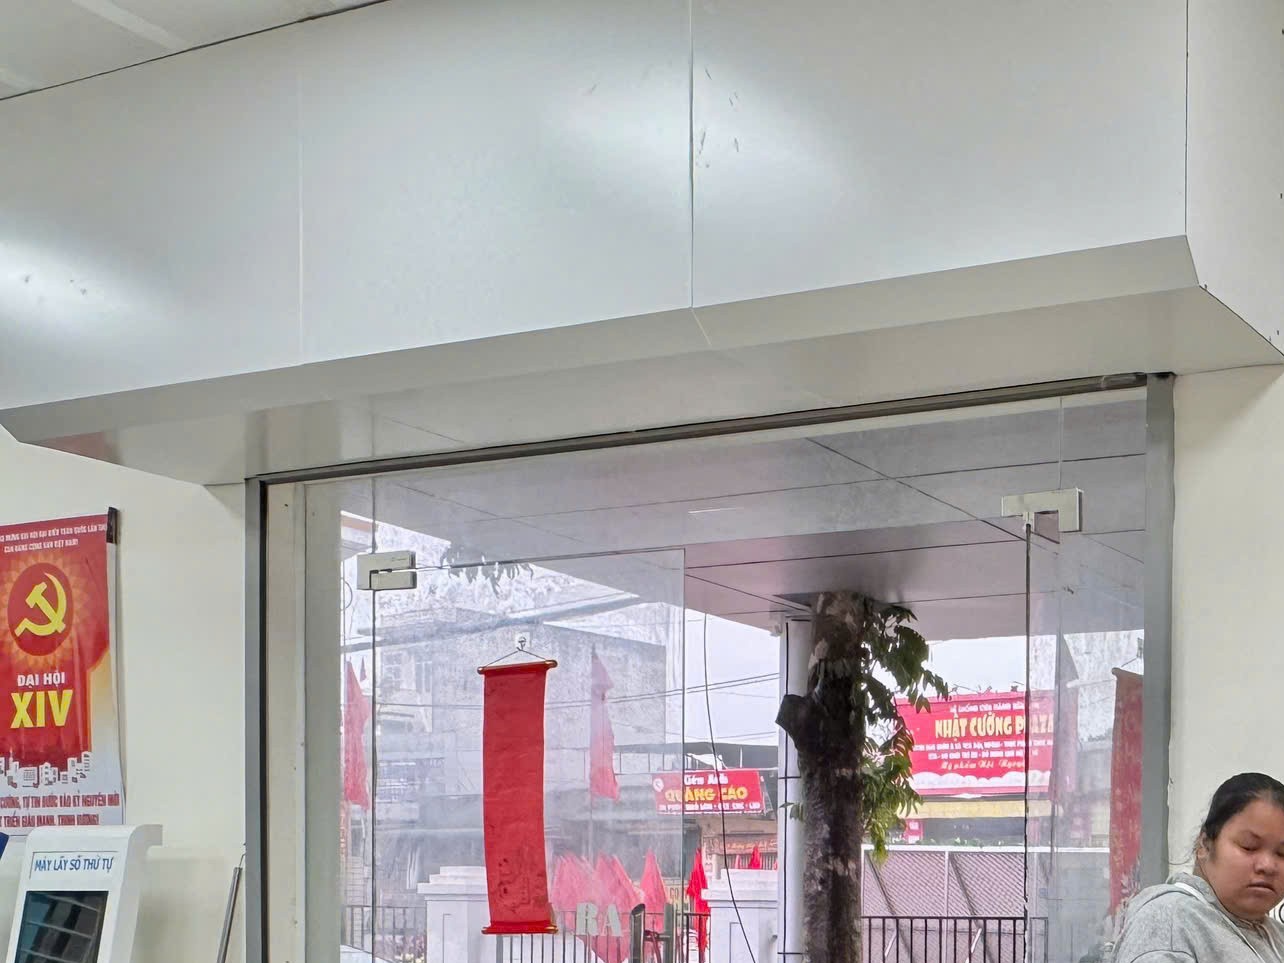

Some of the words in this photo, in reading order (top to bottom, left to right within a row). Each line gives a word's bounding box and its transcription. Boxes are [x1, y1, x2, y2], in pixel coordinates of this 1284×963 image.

[17, 673, 40, 689] ĐẠI
[43, 668, 65, 688] HỘI
[10, 688, 74, 729] XIV
[34, 856, 54, 872] MÁY
[53, 855, 69, 872] LẤY
[69, 854, 81, 871] SỐ
[83, 854, 100, 871] THỨ
[102, 856, 114, 874] TỰ
